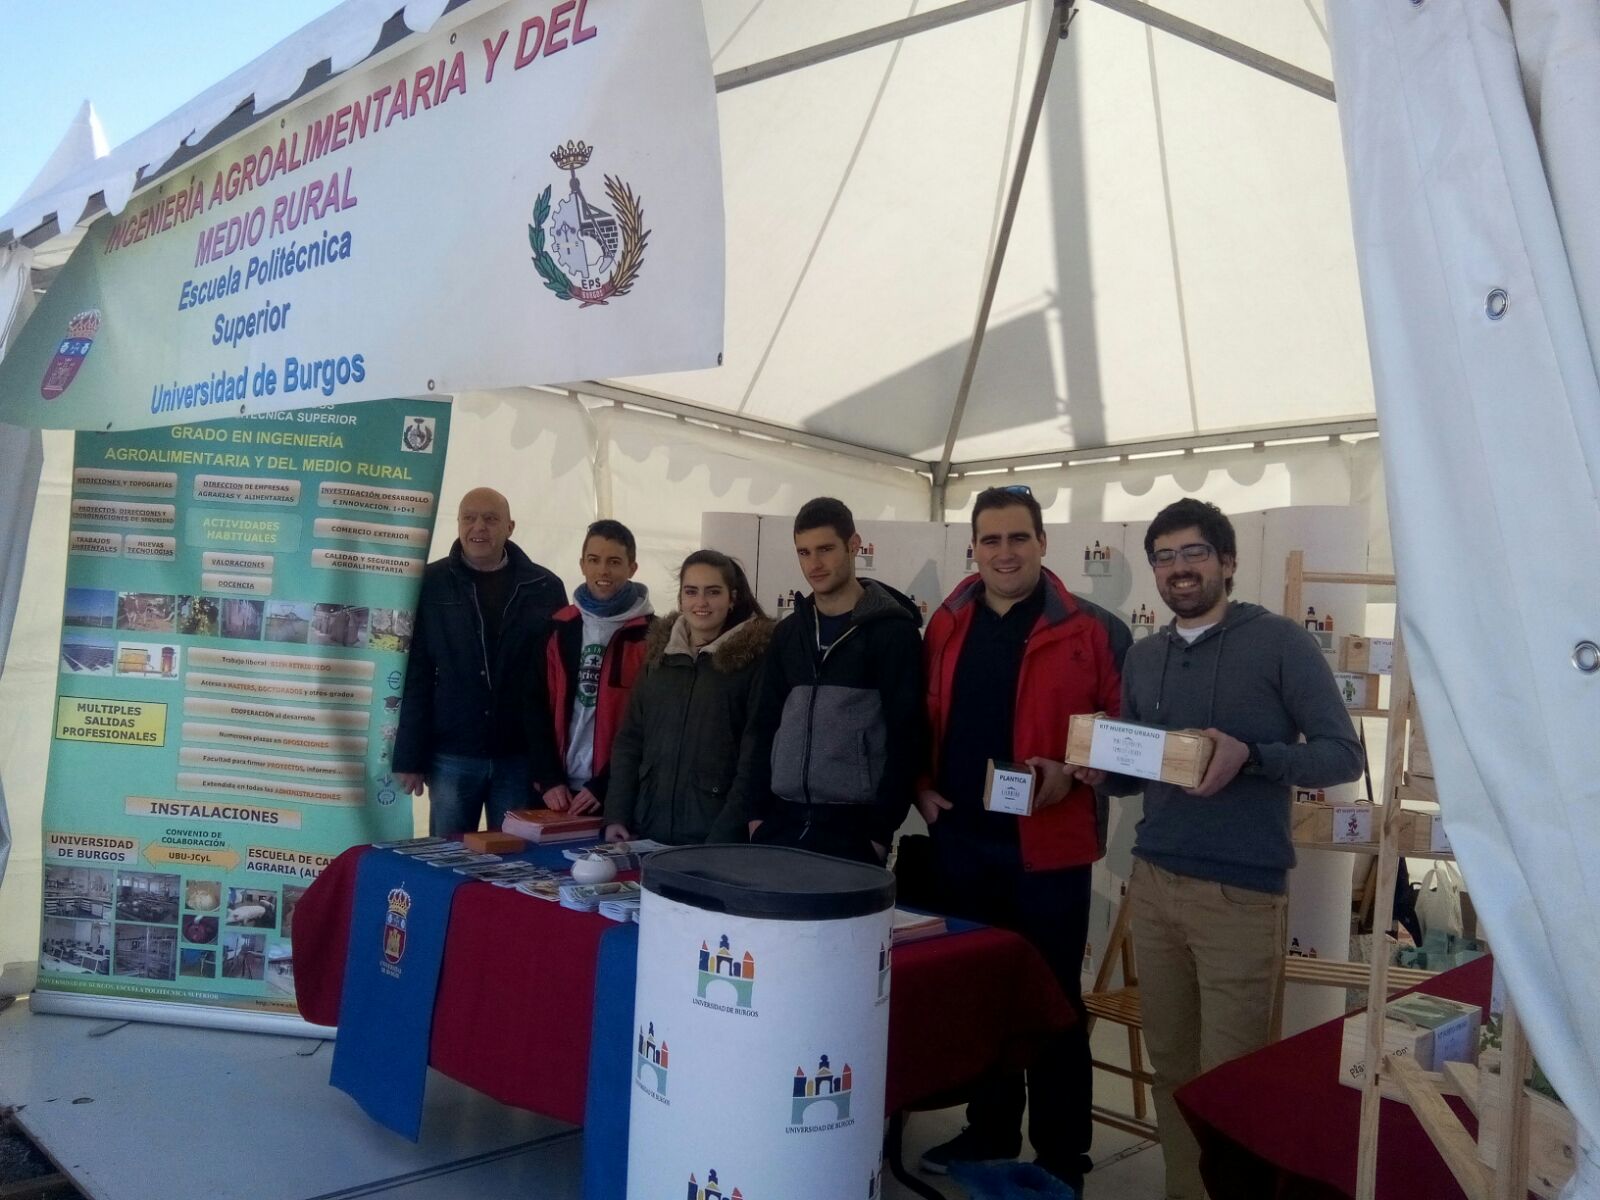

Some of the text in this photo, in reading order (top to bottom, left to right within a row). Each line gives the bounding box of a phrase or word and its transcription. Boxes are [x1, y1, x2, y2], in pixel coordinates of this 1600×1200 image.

[104, 0, 598, 255] INGENIERÍA AGROALIMENTARIA Y DEL
[194, 166, 358, 268] MEDIO RURAL
[178, 230, 352, 312] Escuela Politécnica
[212, 299, 291, 349] Superior
[151, 353, 366, 415] Universidad de Burgos
[297, 412, 357, 426] SUPERIOR
[171, 426, 344, 449] GRADO EN INGENIERÍA
[104, 447, 412, 481] AGROALIMENTARIA Y DEL MEDIO RURAL
[203, 518, 281, 532] ACTIVIDADES
[207, 530, 278, 544] HABITUALES
[331, 525, 410, 541] COMERCIO EXTERIOR
[211, 559, 265, 569] VALORACIONES
[324, 552, 359, 562] CALIDAD
[77, 703, 142, 717] MULTIPLES
[84, 715, 135, 728] SALIDAS
[62, 726, 157, 742] PROFESIONALES
[999, 774, 1027, 785] PLANTICA
[149, 801, 279, 825] INSTALACIONES
[165, 827, 222, 840] CONVENIO DE
[51, 834, 134, 850] UNIVERSIDAD
[161, 836, 226, 848] COLABORACIÓN
[58, 848, 126, 863] DE BURGOS
[168, 851, 212, 864] UBU-JCyL
[248, 848, 333, 867] ESCUELA DE CA
[247, 861, 297, 876] AGRARIA
[692, 998, 726, 1012] UNIVERSIDAD
[734, 1008, 759, 1018] BURGOS
